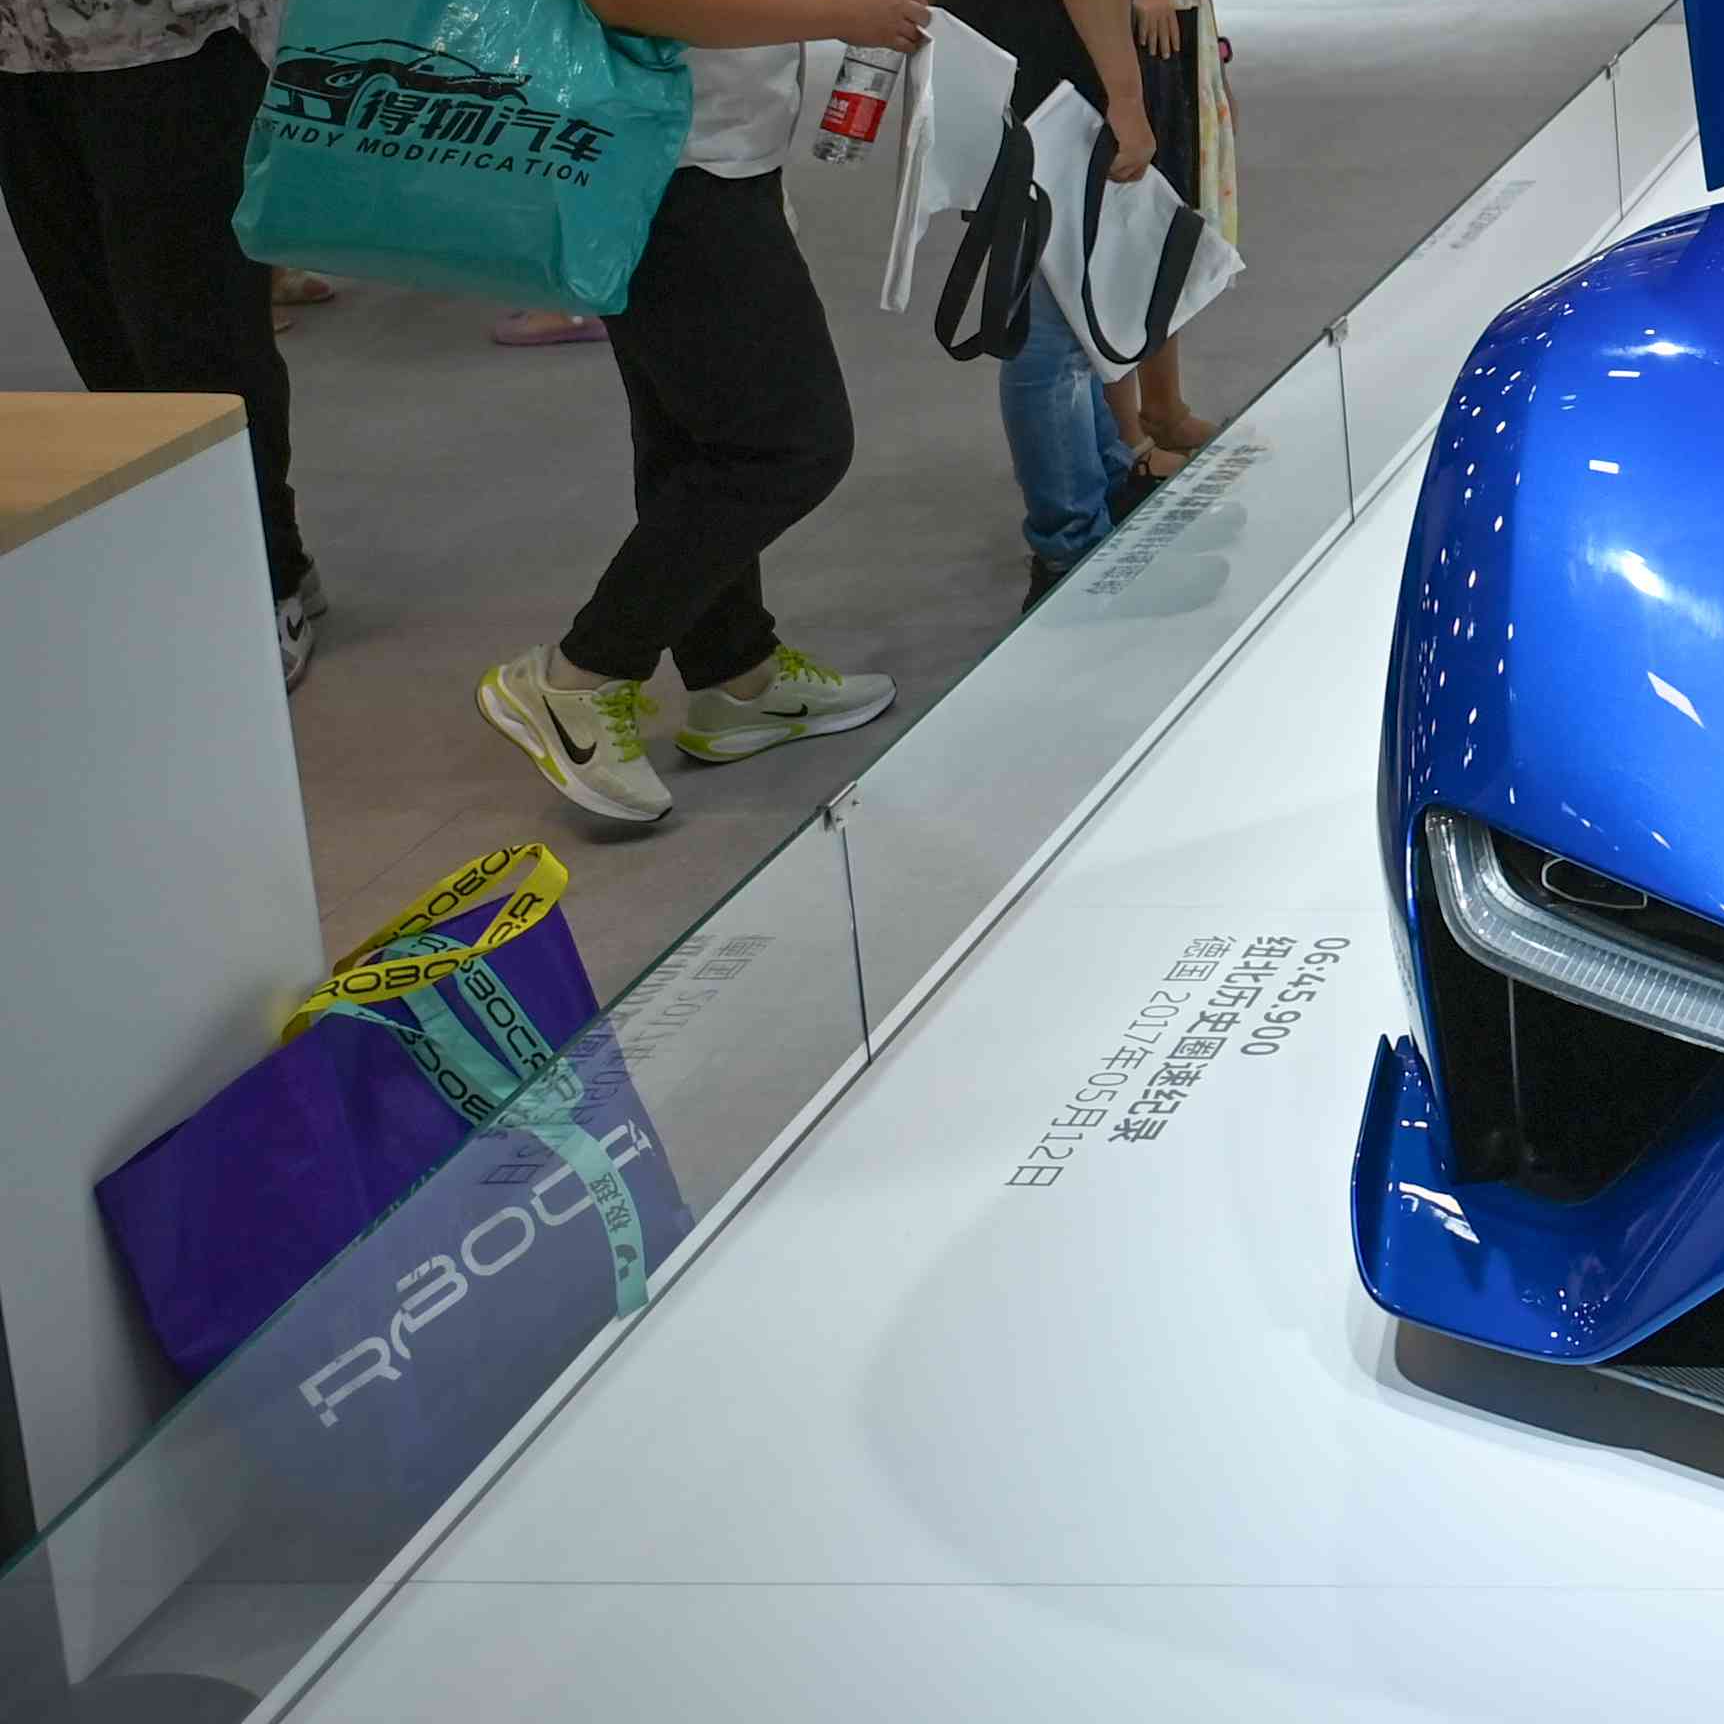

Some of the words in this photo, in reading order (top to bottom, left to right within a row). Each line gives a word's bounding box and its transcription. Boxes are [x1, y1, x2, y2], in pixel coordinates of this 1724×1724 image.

[356, 138, 591, 187] MODIFICATION
[358, 88, 615, 163] 得物汽车
[1162, 935, 1237, 983] 德国
[1240, 936, 1352, 1057] 06:45.900
[1107, 934, 1299, 1143] 纽北历史圈速纪录
[1004, 989, 1192, 1188] 2017年05月12日
